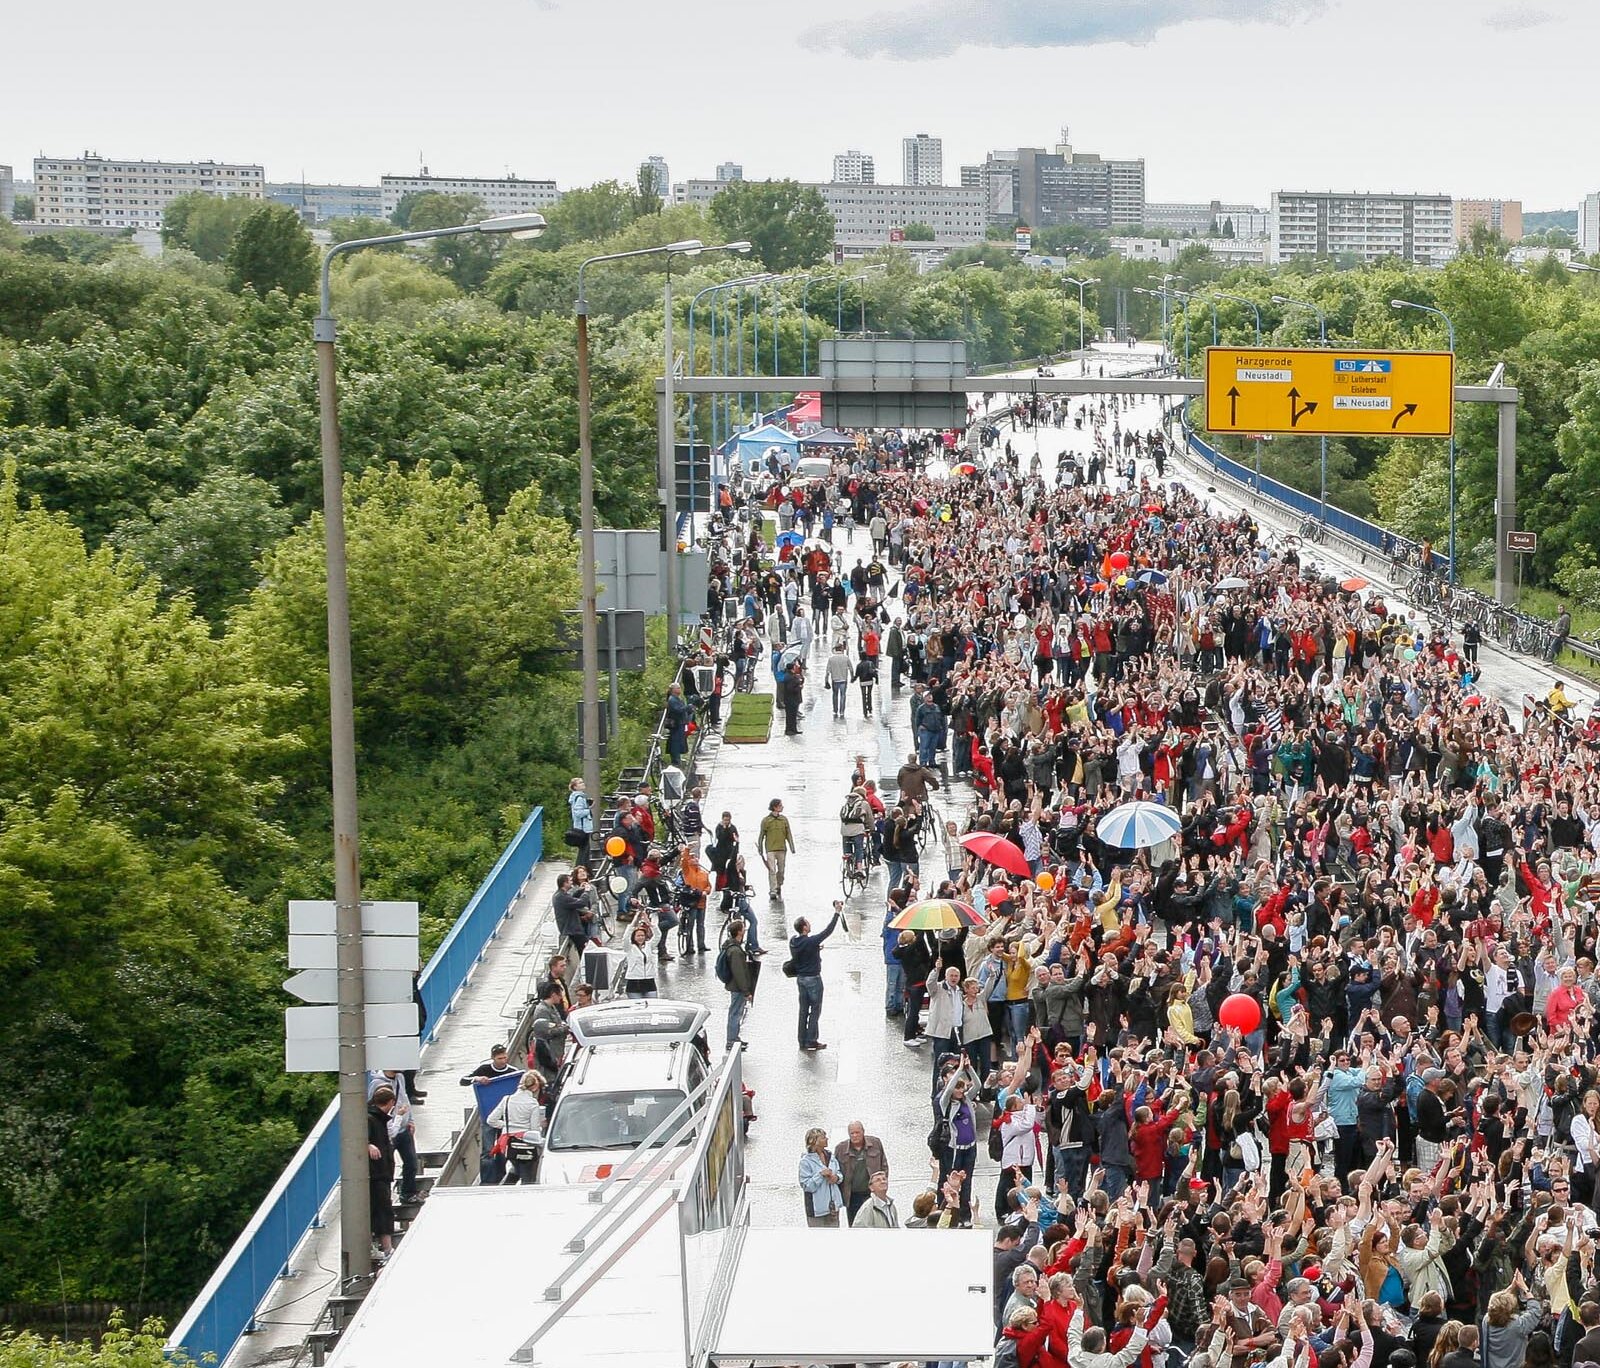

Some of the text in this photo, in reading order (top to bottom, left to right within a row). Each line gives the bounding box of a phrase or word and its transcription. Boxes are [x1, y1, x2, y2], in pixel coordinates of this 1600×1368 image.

[1236, 356, 1292, 367] Harzgerode
[1245, 371, 1283, 380] Neustadt
[1351, 375, 1387, 383] Lutherstadt
[1351, 386, 1377, 394] Eisleben
[1351, 398, 1389, 407] Neustadt
